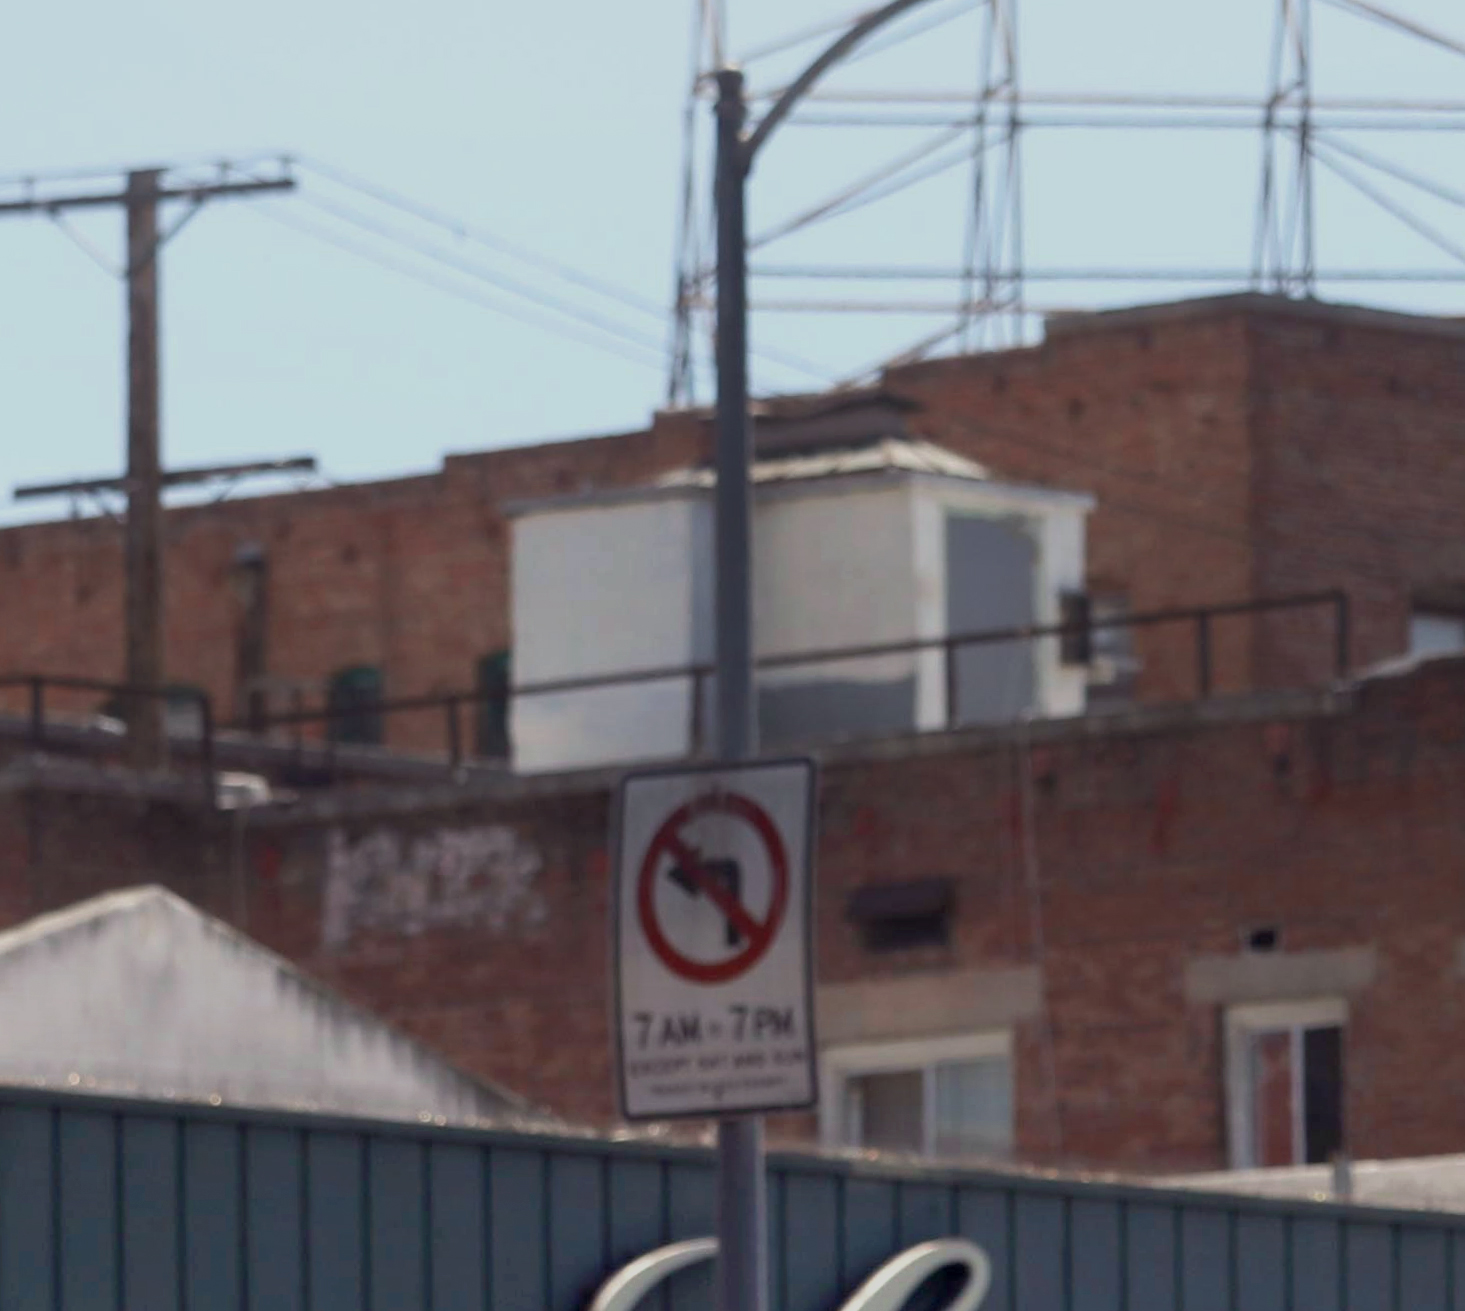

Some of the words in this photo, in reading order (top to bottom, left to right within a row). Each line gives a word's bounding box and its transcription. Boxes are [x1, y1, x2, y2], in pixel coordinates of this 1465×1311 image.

[634, 1012, 653, 1049] 7
[660, 1014, 702, 1045] AM
[729, 1004, 750, 1042] 7
[754, 1006, 795, 1039] PM
